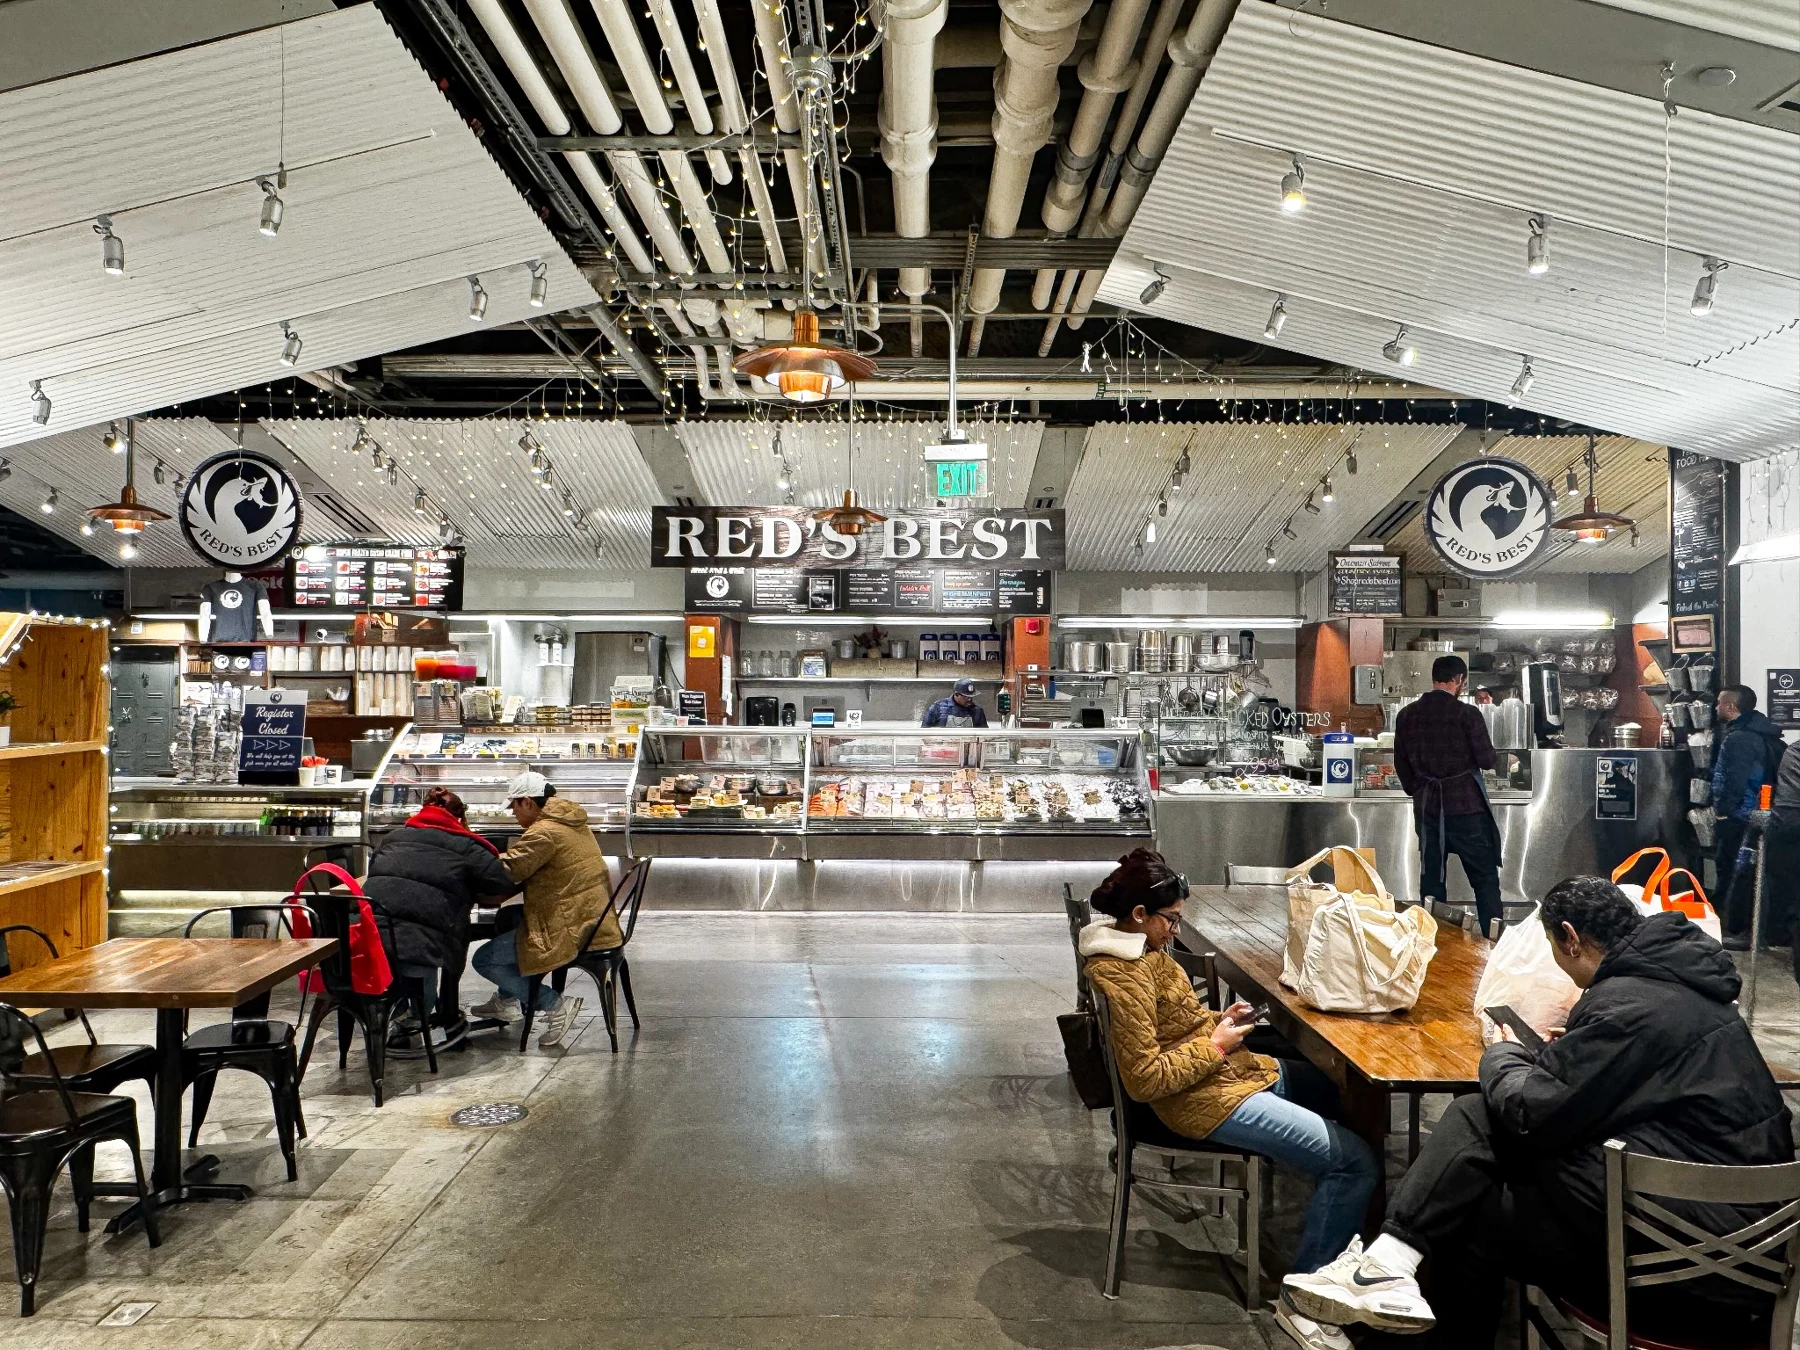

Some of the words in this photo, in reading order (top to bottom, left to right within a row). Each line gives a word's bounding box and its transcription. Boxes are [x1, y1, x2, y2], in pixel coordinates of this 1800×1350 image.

[937, 463, 978, 497] EXIT
[200, 529, 243, 557] RED'S
[247, 529, 283, 557] BEST
[664, 516, 857, 560] RED'S
[880, 517, 1053, 560] BEST
[1445, 537, 1492, 564] RED'S
[1496, 532, 1535, 563] BEST
[255, 706, 294, 722] Register
[1272, 707, 1331, 727] OYSTERS
[259, 723, 290, 735] Closed
